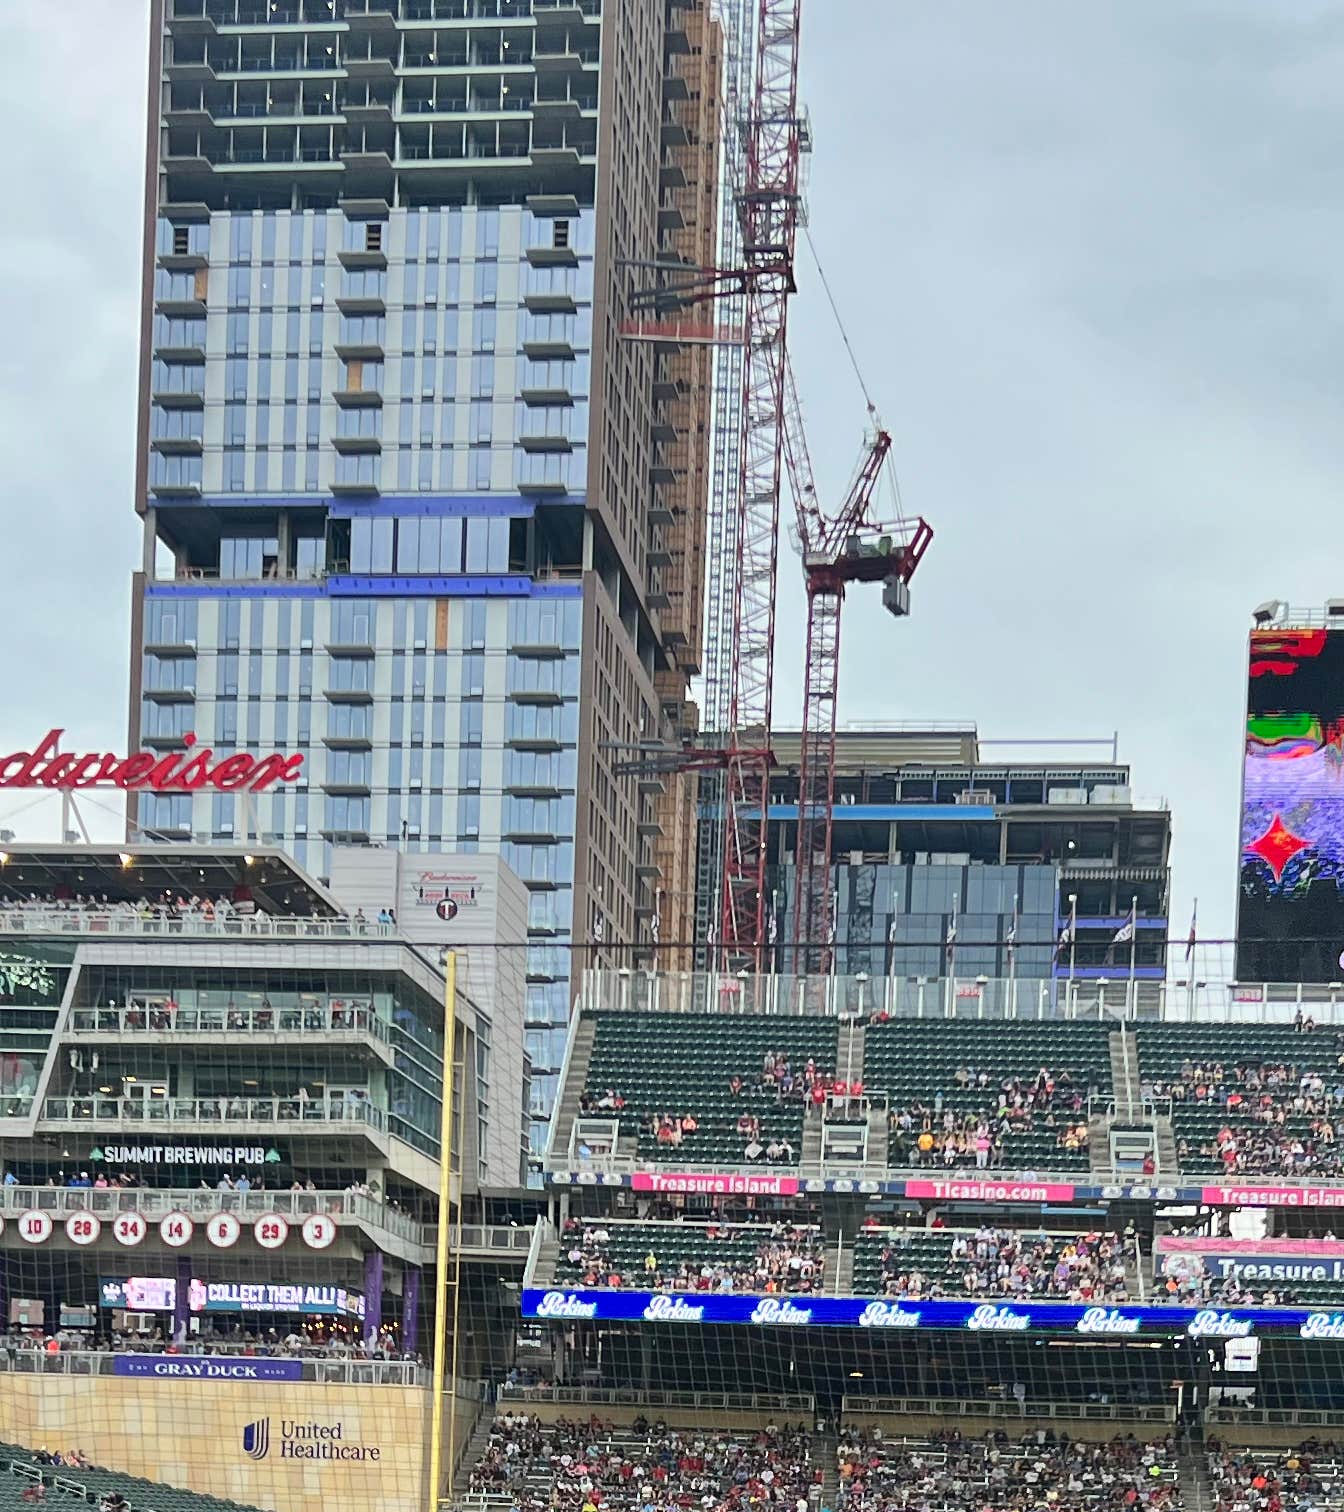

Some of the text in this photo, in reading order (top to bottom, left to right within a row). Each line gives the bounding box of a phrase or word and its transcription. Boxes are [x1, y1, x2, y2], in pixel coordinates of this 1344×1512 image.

[104, 1146, 265, 1164] SUMMIT BREWING PUB
[650, 1174, 781, 1194] Treasure Island
[1220, 1187, 1300, 1206] Treasure
[27, 1219, 42, 1234] 10
[74, 1220, 92, 1235] 28
[120, 1221, 139, 1236] 34
[168, 1222, 183, 1237] 14
[218, 1222, 228, 1238] 6
[262, 1223, 279, 1239] 29
[314, 1224, 323, 1239] 3
[1218, 1258, 1328, 1281] Treasure
[208, 1284, 336, 1305] COLLECT THEM ALL!
[536, 1291, 596, 1319] Perkins
[644, 1294, 703, 1322] Perkins
[752, 1298, 811, 1325] Perkins
[858, 1301, 919, 1328] Perkins
[967, 1305, 1030, 1331] Perkins
[1077, 1307, 1141, 1334] Perkins
[1188, 1310, 1252, 1338] Perkins
[155, 1363, 204, 1376] GRAY
[207, 1364, 257, 1377] DUCK
[281, 1420, 342, 1440] United
[281, 1440, 381, 1461] Healthcare
